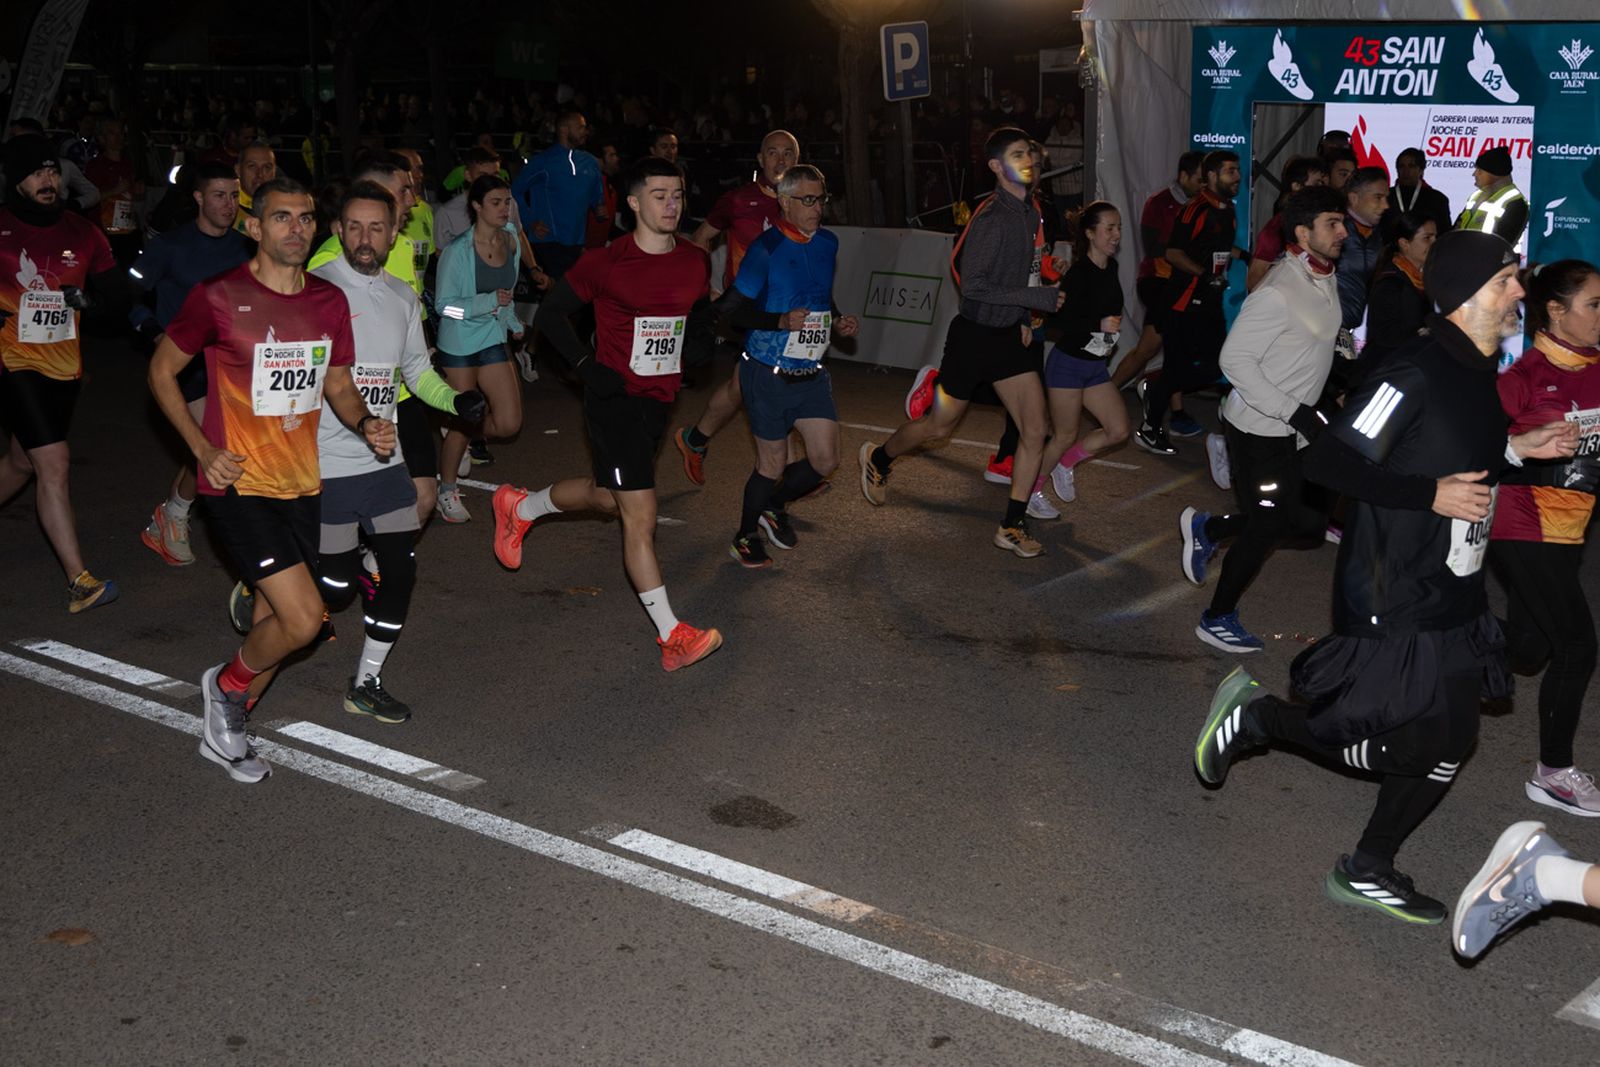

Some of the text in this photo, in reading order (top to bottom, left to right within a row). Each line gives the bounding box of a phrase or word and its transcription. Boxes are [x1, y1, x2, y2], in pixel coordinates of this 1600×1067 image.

[512, 41, 545, 64] WC
[1344, 36, 1445, 66] 43 SAN
[893, 32, 920, 91] P
[1281, 68, 1299, 89] 43
[1333, 61, 1438, 96] ANTÓN
[1482, 69, 1503, 91] 43
[1549, 71, 1600, 80] CAJA RURAL
[1432, 115, 1467, 123] CARRERA
[1468, 115, 1499, 123] URBANA
[1193, 132, 1246, 144] calderón
[1430, 126, 1479, 135] NOCHE DE
[1426, 136, 1475, 158] SAN
[1537, 143, 1600, 155] calderón
[870, 287, 932, 310] ALISEA
[32, 309, 68, 326] 4765
[798, 329, 827, 344] 6363
[274, 351, 295, 359] NOCHE
[296, 350, 305, 358] DE
[644, 337, 676, 355] 2193
[263, 360, 280, 369] SAN
[281, 359, 306, 369] ANTÓN
[269, 367, 317, 391] 2024
[360, 386, 396, 405] 2025
